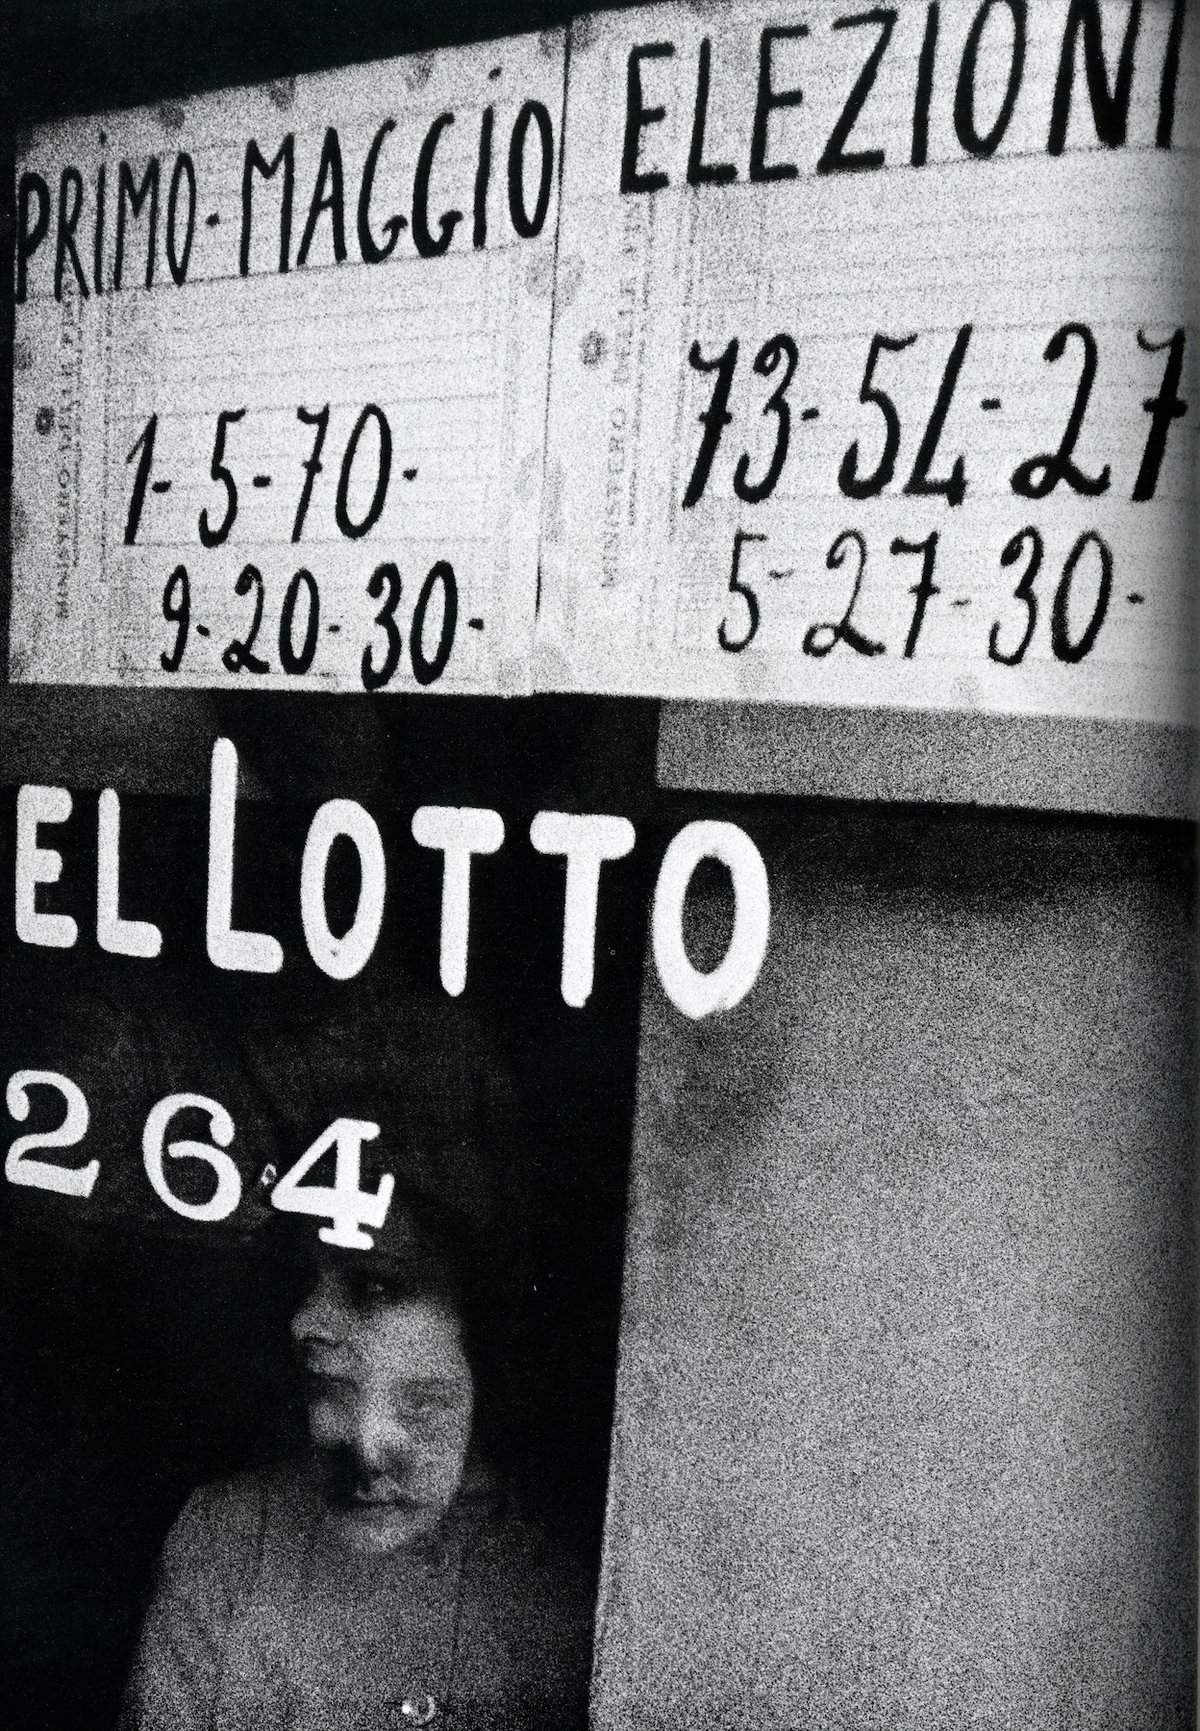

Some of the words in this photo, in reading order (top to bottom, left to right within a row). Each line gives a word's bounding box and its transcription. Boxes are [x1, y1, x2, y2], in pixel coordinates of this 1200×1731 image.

[619, 0, 1187, 195] ELEZIONI
[15, 784, 163, 958] EL
[205, 737, 771, 1020] LOTTO
